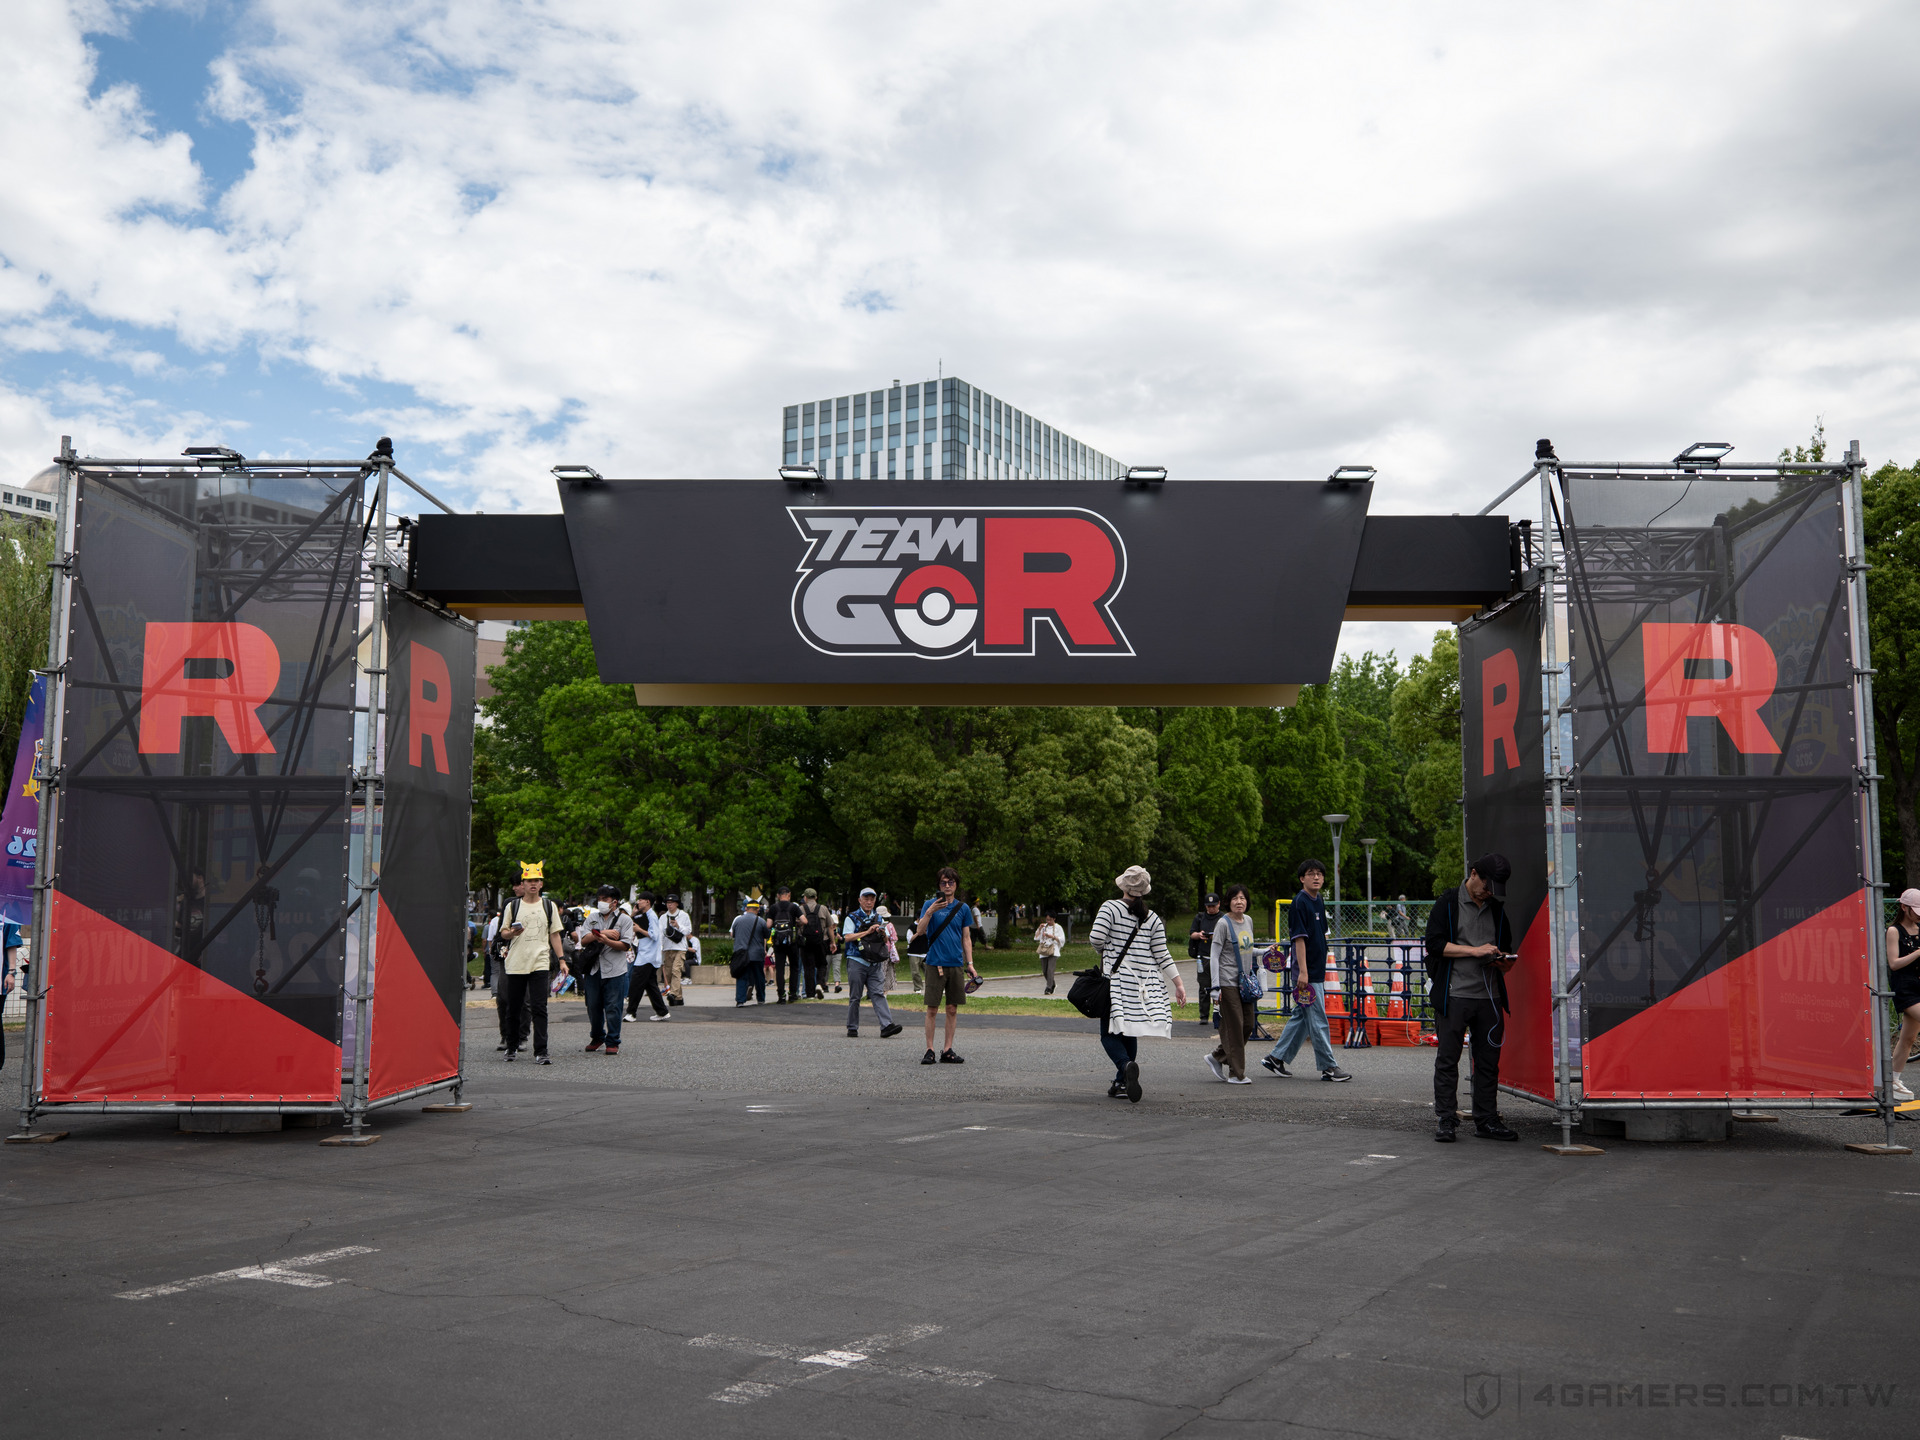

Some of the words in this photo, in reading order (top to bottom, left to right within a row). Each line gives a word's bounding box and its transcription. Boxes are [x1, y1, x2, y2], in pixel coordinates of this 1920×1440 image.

[805, 517, 977, 562] TEAM
[138, 622, 281, 754] R
[409, 641, 452, 775] R
[1482, 648, 1521, 777] R
[1641, 622, 1782, 754] R
